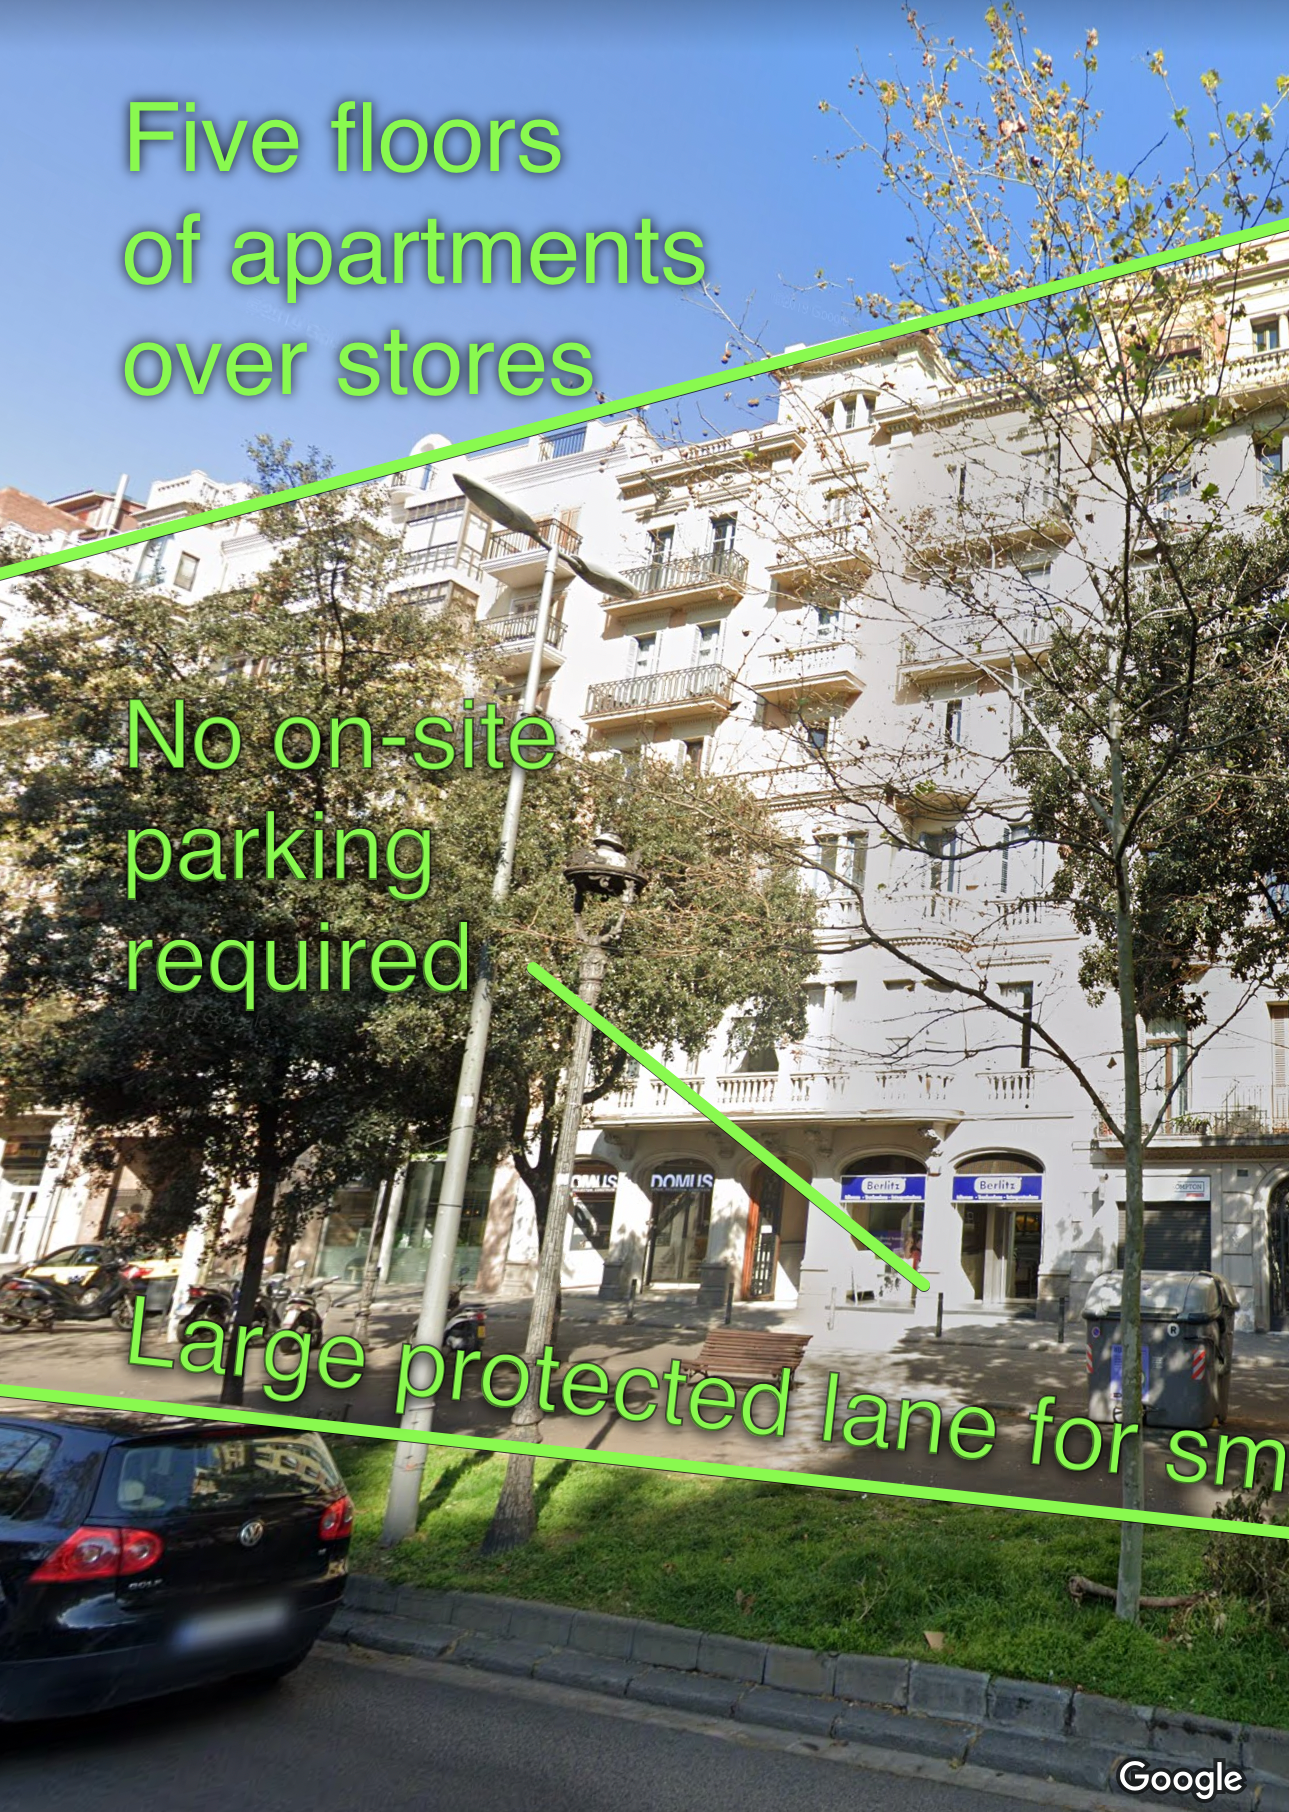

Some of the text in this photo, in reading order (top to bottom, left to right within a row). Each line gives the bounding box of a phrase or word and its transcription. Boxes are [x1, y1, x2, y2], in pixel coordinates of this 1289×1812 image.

[650, 1173, 713, 1188] DOMUS
[866, 1180, 900, 1191] Berlitz
[979, 1179, 1016, 1190] Berlitz
